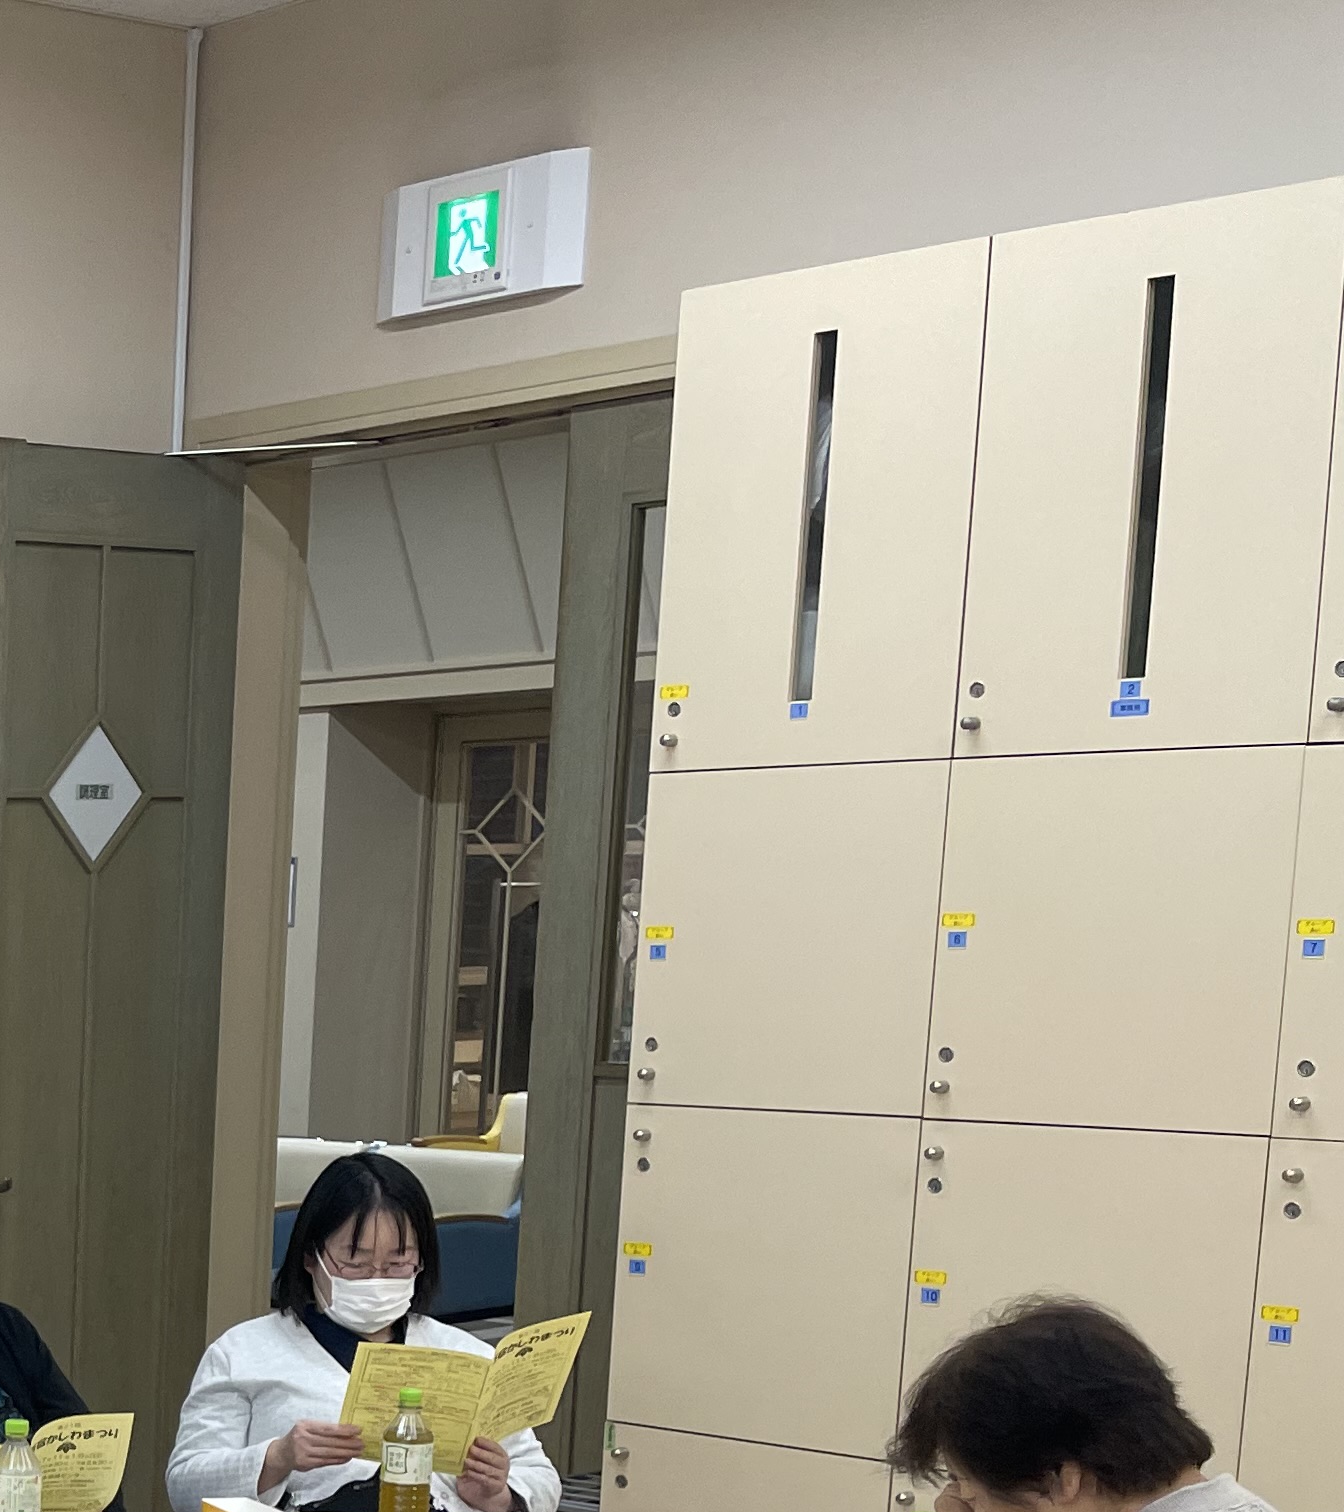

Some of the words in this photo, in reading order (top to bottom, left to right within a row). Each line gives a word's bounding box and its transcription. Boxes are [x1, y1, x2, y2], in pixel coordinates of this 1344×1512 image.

[1127, 683, 1135, 695] 2
[954, 934, 961, 944] 6
[655, 947, 661, 956] 5
[1310, 942, 1318, 953] 7
[926, 1290, 938, 1301] 10
[1275, 1328, 1287, 1341] 11
